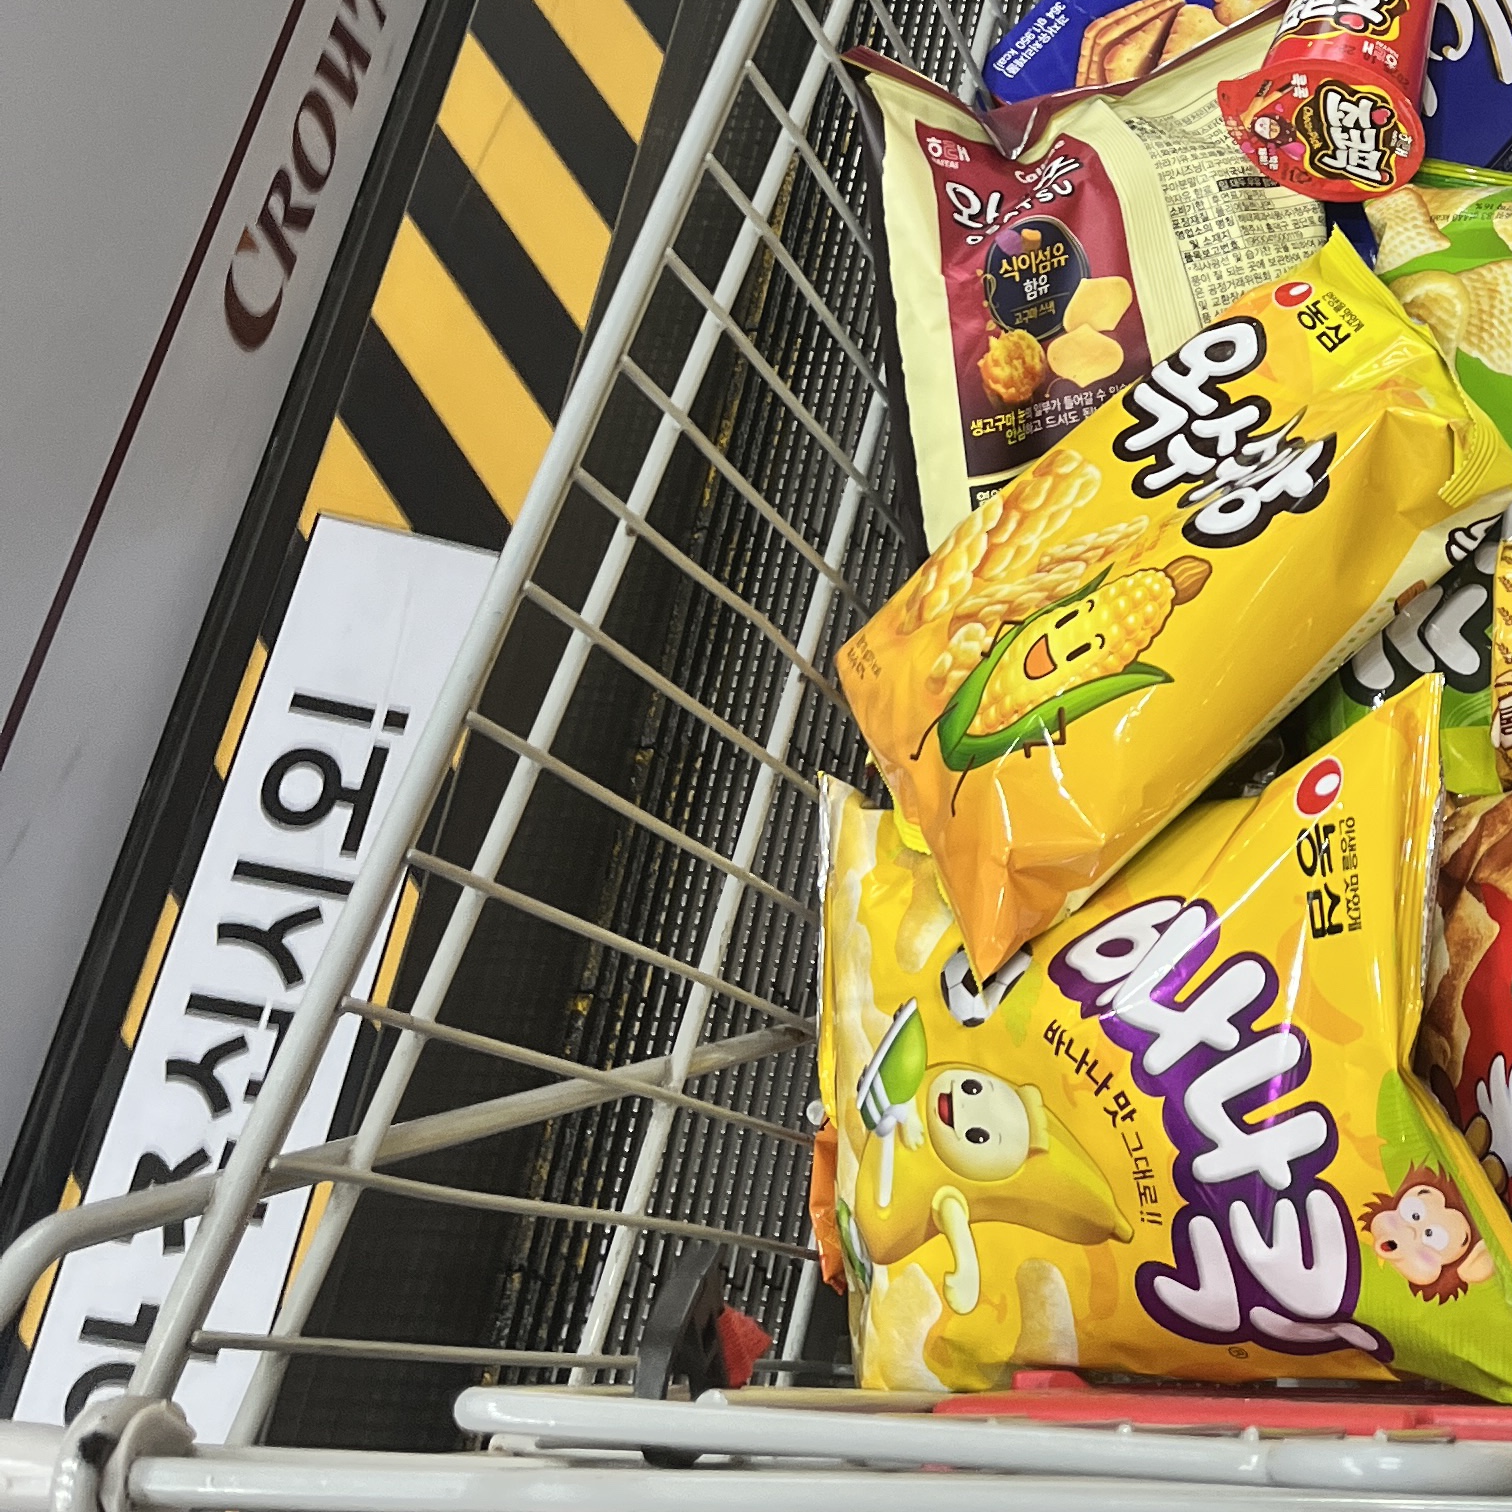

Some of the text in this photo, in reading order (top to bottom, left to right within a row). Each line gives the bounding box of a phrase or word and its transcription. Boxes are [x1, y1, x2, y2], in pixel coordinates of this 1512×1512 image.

[1044, 0, 1066, 21] 364
[991, 45, 1018, 73] kcal)
[1169, 201, 1205, 217] 소비기한
[1171, 212, 1209, 228] 포장재질
[1174, 217, 1235, 240] 영업소의 명칭
[1202, 230, 1231, 245] 소재지
[999, 245, 1070, 278] 식이섬유
[1225, 263, 1244, 275] 되는
[1247, 259, 1265, 271] 곳에
[1267, 251, 1300, 267] 보관하여
[1022, 275, 1051, 300] 함유
[1207, 272, 1272, 295] 공정거래위원회
[1296, 299, 1351, 353] 농심
[1322, 291, 1365, 334] 인생을 맛있게
[969, 412, 1017, 438] 생고구마
[1062, 393, 1096, 415] 들어갈
[1095, 389, 1108, 406] 수
[1044, 409, 1080, 432] 드셔도
[1122, 320, 1324, 536] 옥수수깡
[1295, 826, 1346, 940] 농심
[1337, 815, 1364, 936] 인생을 맛있게
[1041, 1018, 1163, 1228] 바나나 맛 그대로!!
[1065, 899, 1379, 1352] 바나나킥
